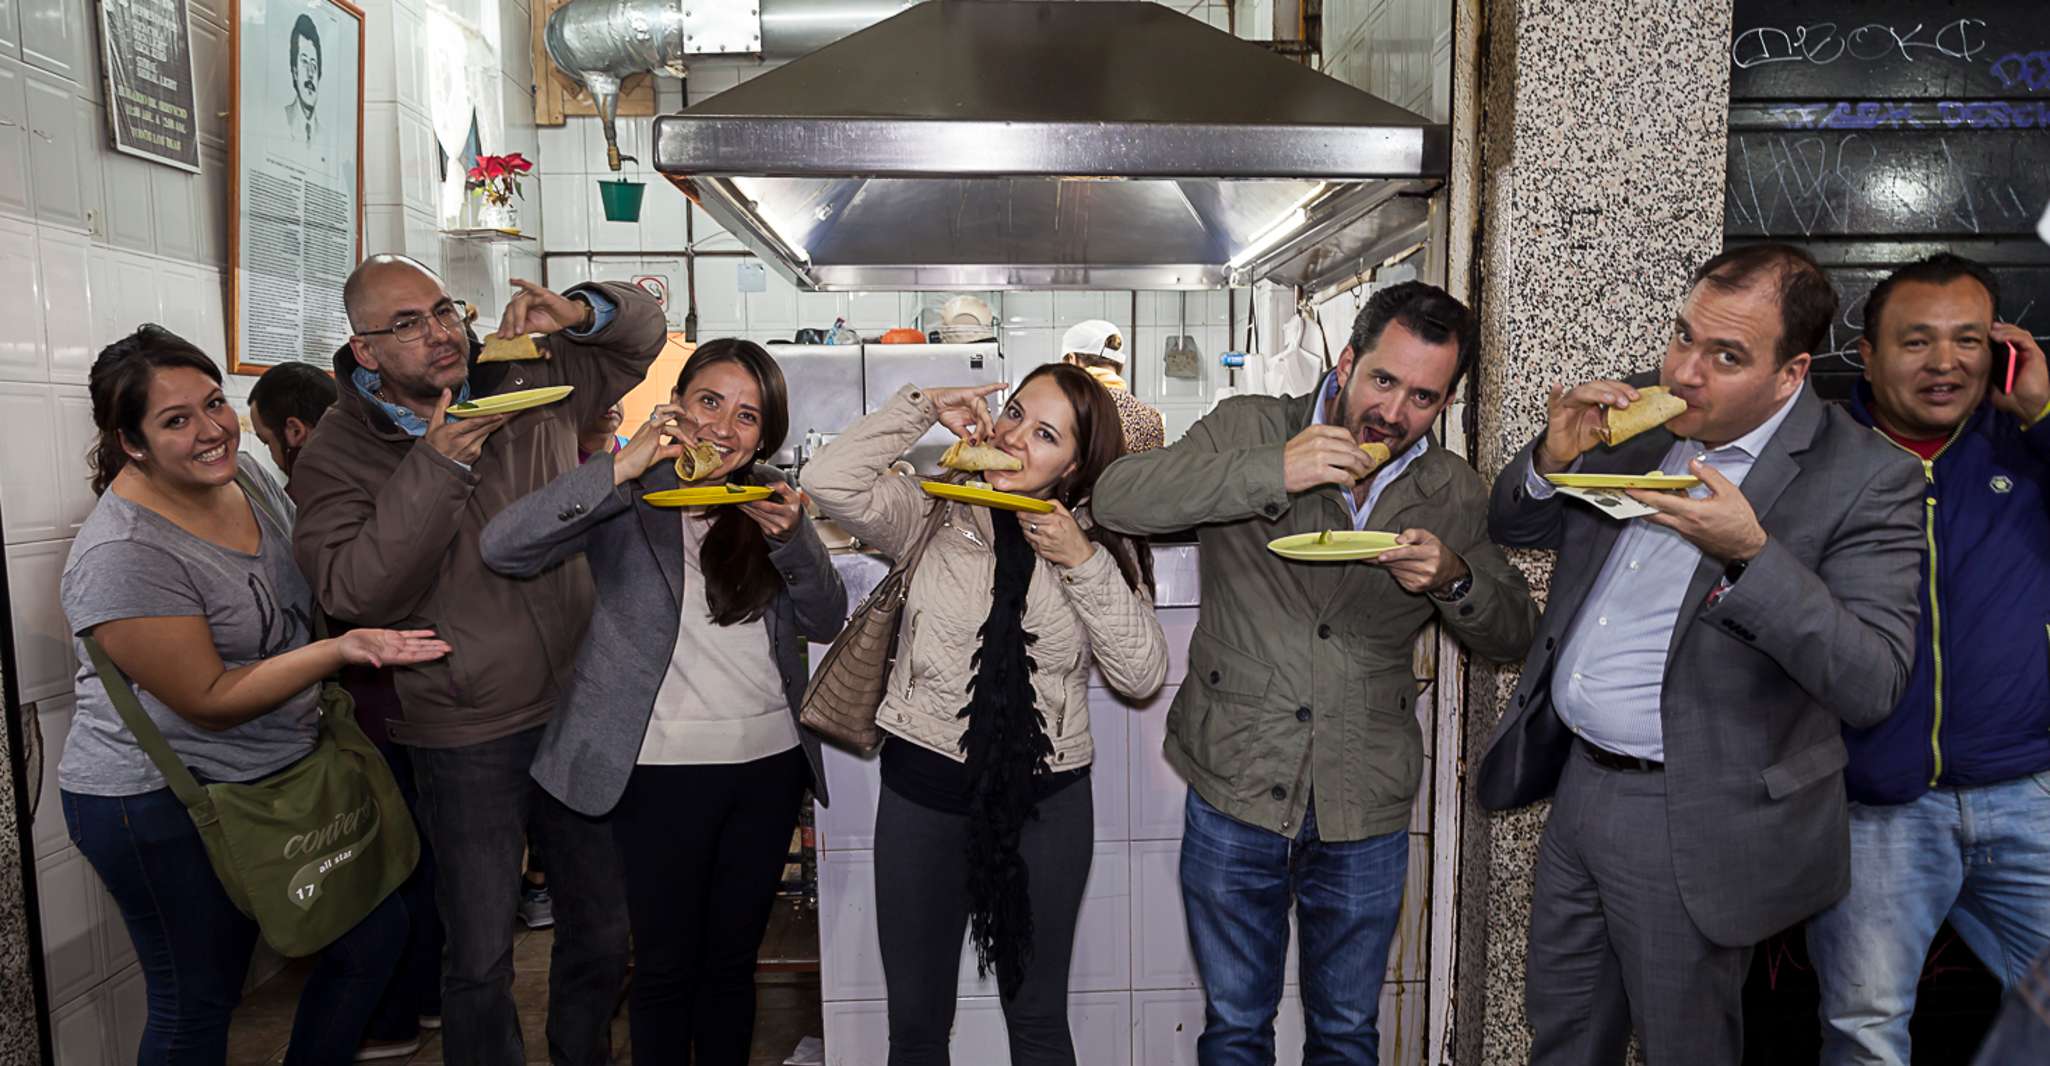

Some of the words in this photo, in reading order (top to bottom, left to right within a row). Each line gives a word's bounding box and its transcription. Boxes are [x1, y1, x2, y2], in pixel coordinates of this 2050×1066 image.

[319, 859, 333, 873] all
[334, 850, 353, 864] star
[296, 883, 315, 900] 17
